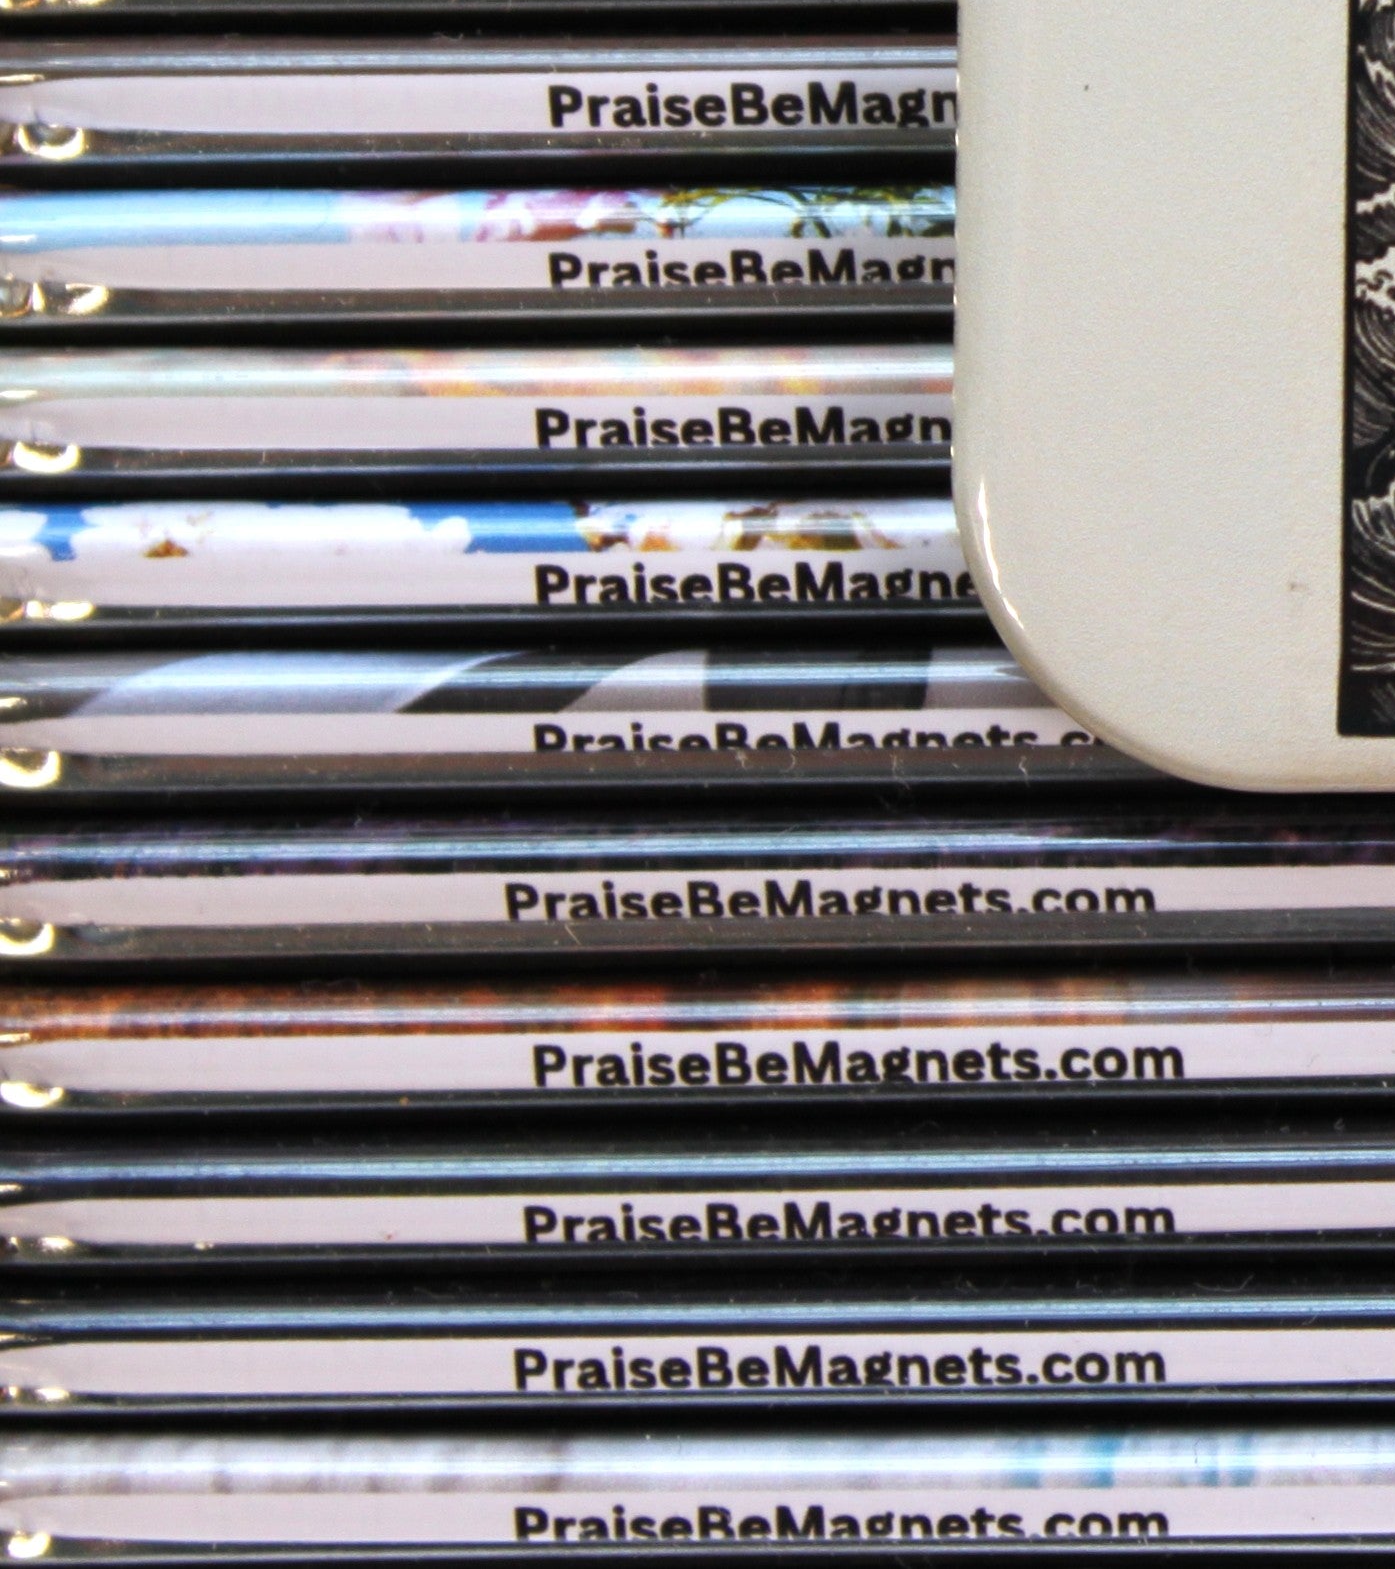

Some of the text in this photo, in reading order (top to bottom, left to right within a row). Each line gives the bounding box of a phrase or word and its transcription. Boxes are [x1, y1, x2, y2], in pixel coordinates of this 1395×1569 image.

[549, 82, 958, 129] PraiseBeMagn
[549, 249, 955, 287] PraiseBeMagn
[536, 407, 951, 447] PraiseBeMagn
[536, 562, 976, 603] PraiseBeMagne
[533, 1041, 1184, 1086] PraiseBeMagnets.com
[514, 1346, 1166, 1389] PraiseBeMagnets.com
